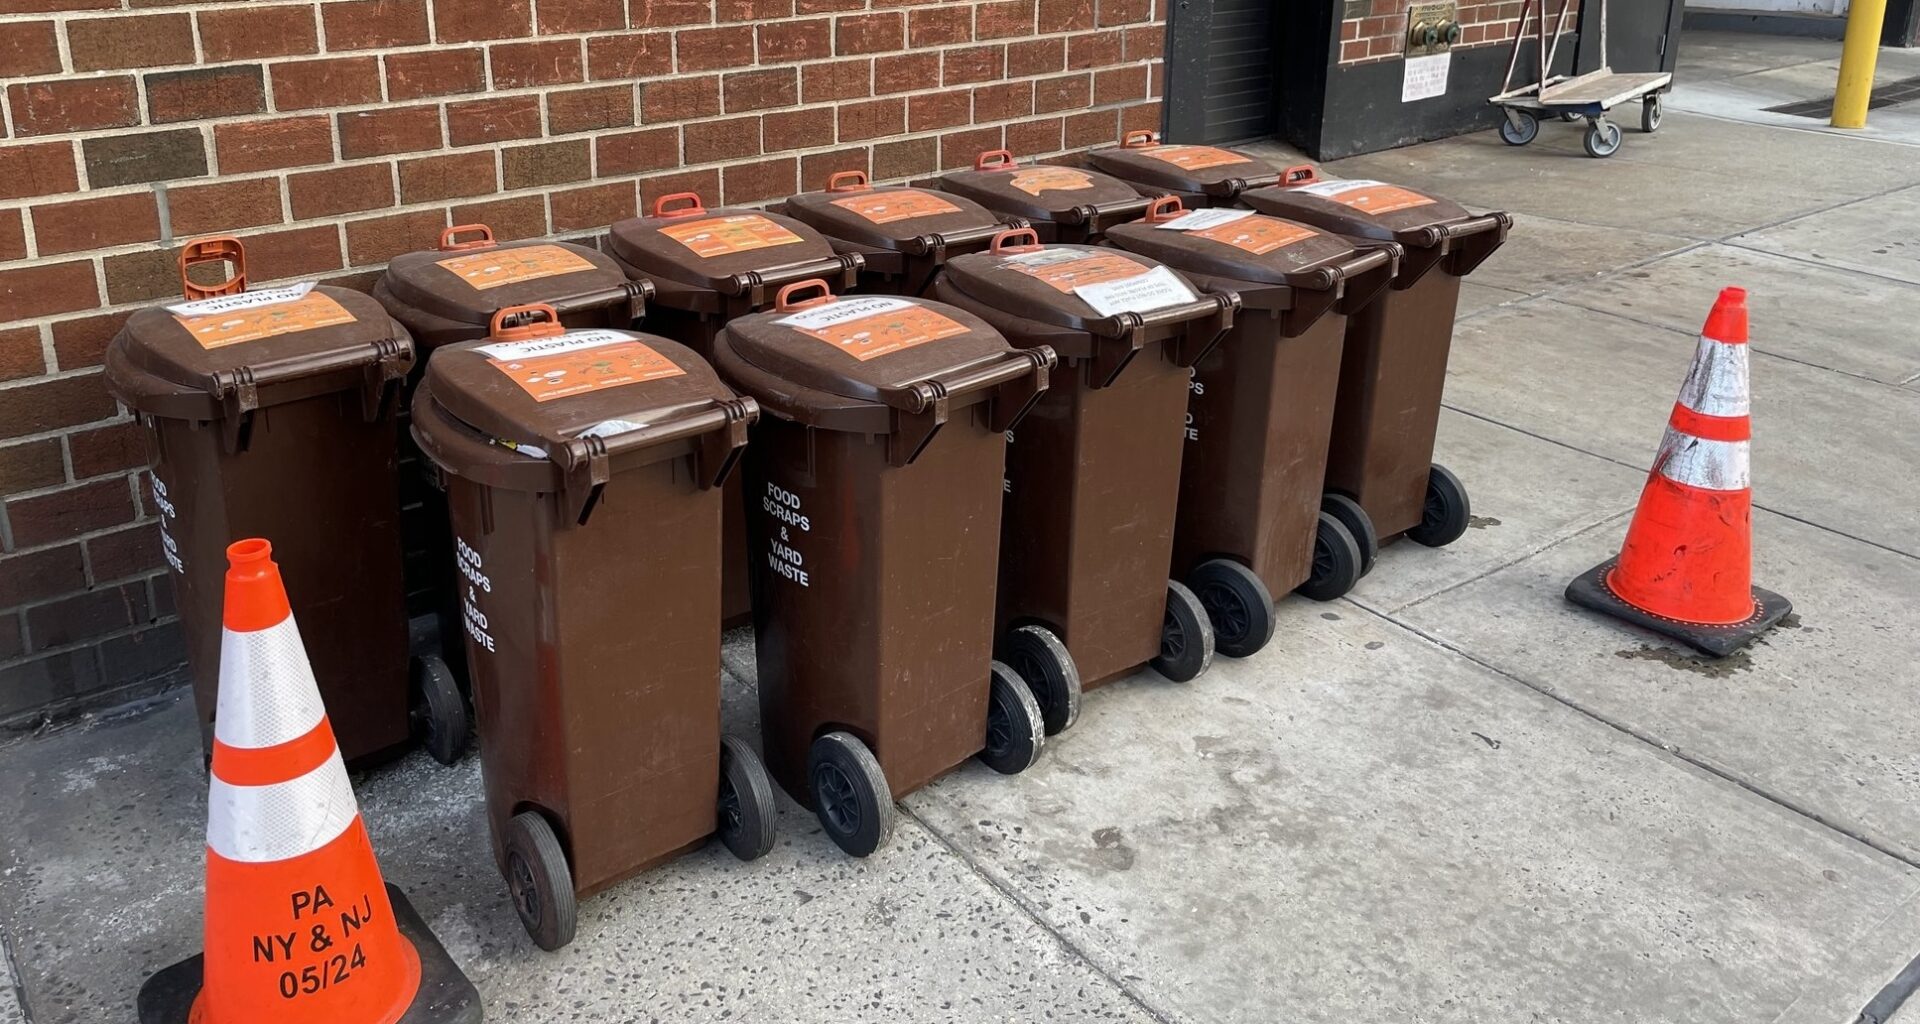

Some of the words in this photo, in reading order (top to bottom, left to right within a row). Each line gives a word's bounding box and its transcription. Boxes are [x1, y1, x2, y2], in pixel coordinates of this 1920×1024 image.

[207, 296, 272, 311] PLASTIC
[819, 306, 871, 321] PLASTIC
[519, 339, 584, 353] PLASTIC
[587, 335, 613, 343] NO
[768, 481, 801, 510] FOOD
[763, 495, 810, 532] SCRAPS
[780, 526, 790, 542] &
[457, 536, 482, 569] FOOD
[770, 538, 803, 566] YARD
[768, 552, 809, 587] WASTE
[469, 585, 477, 603] &
[464, 597, 488, 630] YARD
[464, 612, 495, 653] WASTE
[291, 884, 335, 921] PA
[253, 932, 297, 963] NY
[310, 924, 334, 953] &
[340, 894, 372, 938] NJ
[279, 942, 366, 999] 05/24
